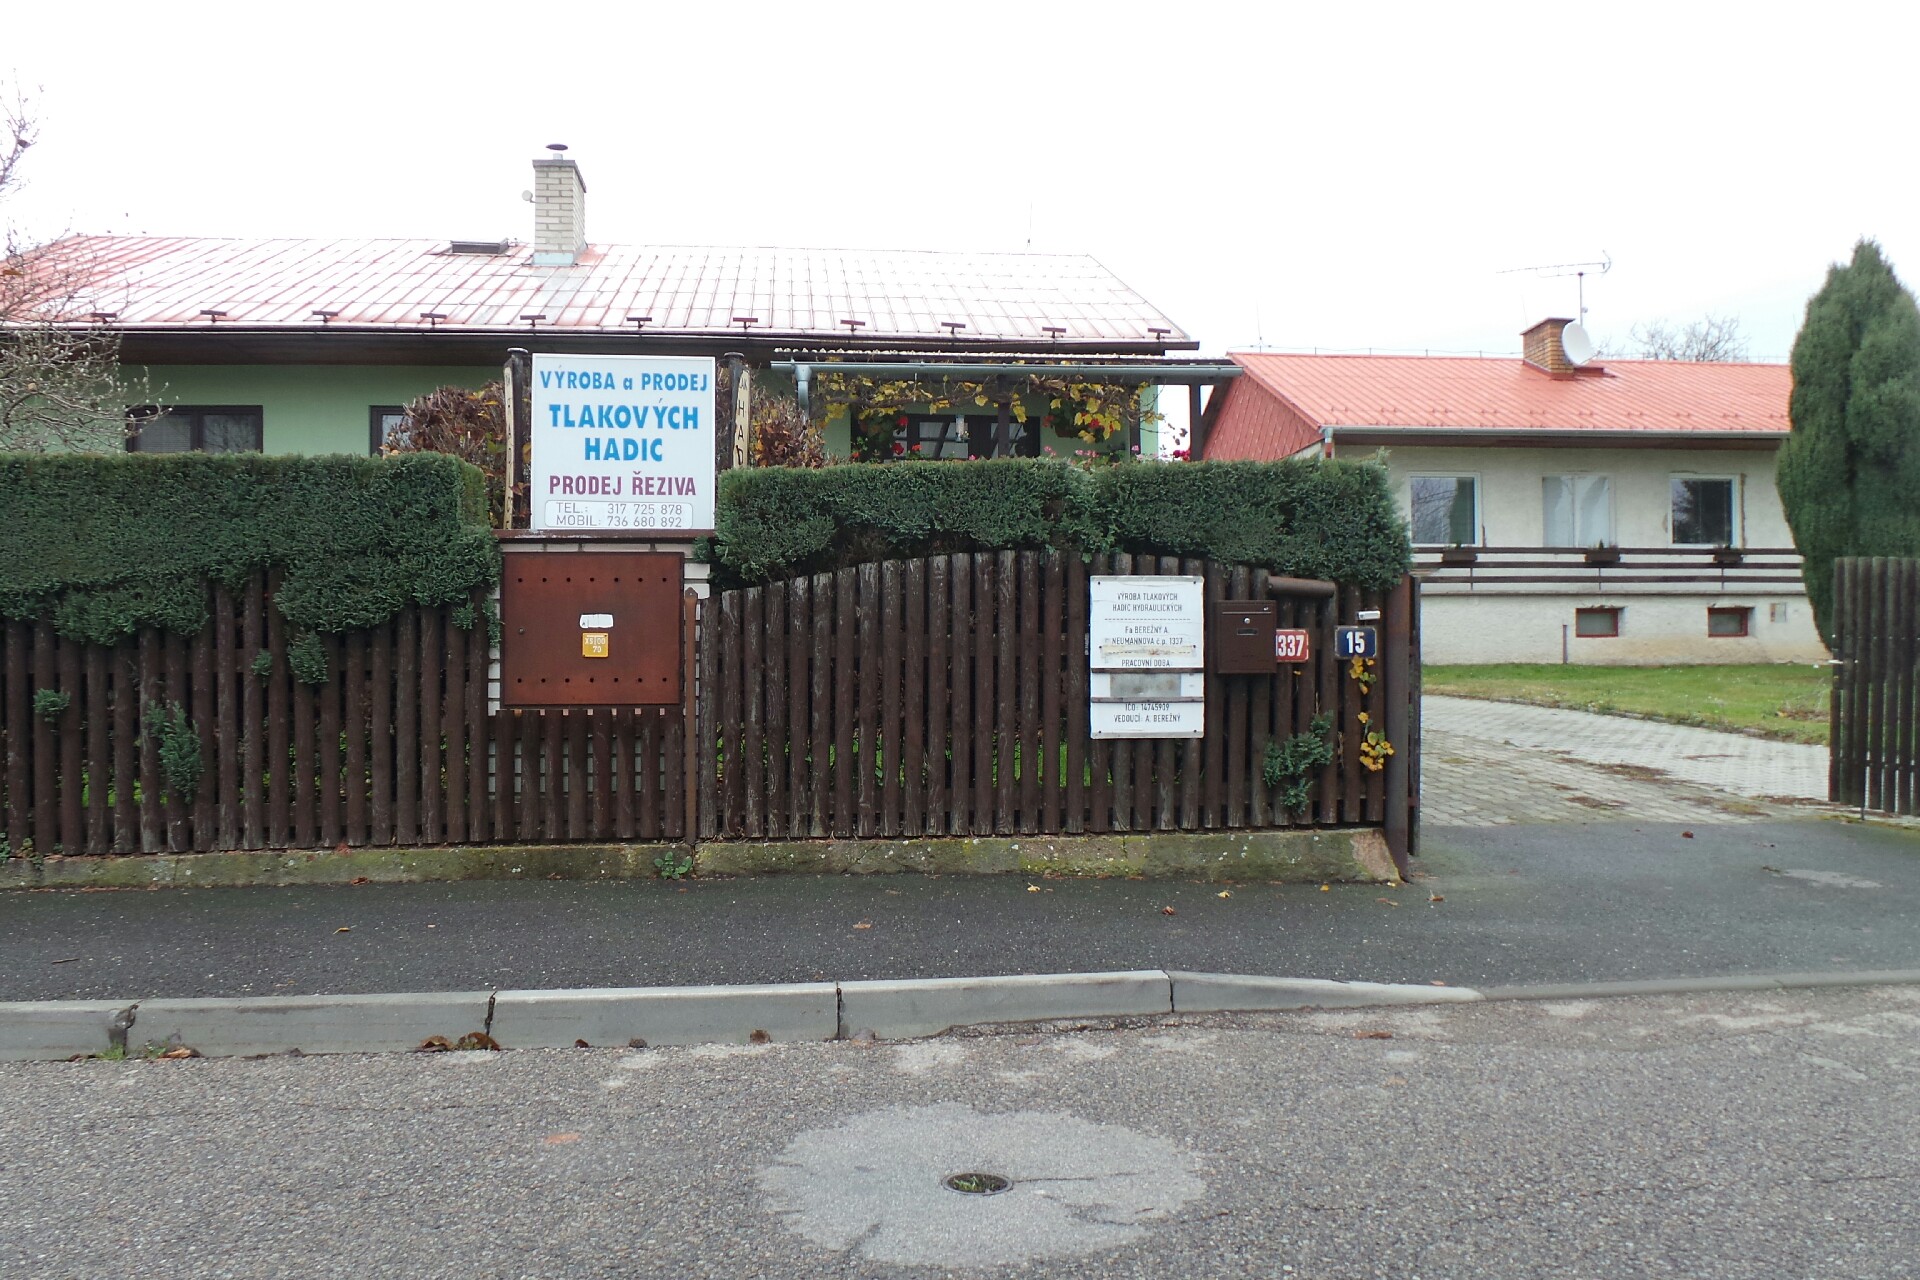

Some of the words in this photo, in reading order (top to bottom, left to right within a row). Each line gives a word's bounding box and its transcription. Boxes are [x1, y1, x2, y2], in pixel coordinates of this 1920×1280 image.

[540, 364, 616, 390] VÝROBA
[623, 377, 633, 390] a
[641, 373, 708, 392] PRODEJ
[549, 398, 699, 430] TLAKOVÝCH
[584, 437, 663, 462] HADIC
[549, 475, 622, 495] PRODEJ
[632, 470, 697, 496] ŘEZIVA
[556, 514, 601, 527] MOBIL:
[607, 516, 628, 528] 736
[633, 516, 655, 528] 680
[660, 516, 683, 528] 892
[607, 503, 626, 515] 317
[634, 503, 655, 515] 725
[660, 504, 683, 516] 878
[1112, 603, 1132, 612] HADIC
[1112, 637, 1154, 645] NEUMANNOVA
[1169, 637, 1183, 645] 1337
[1346, 631, 1365, 654] 15
